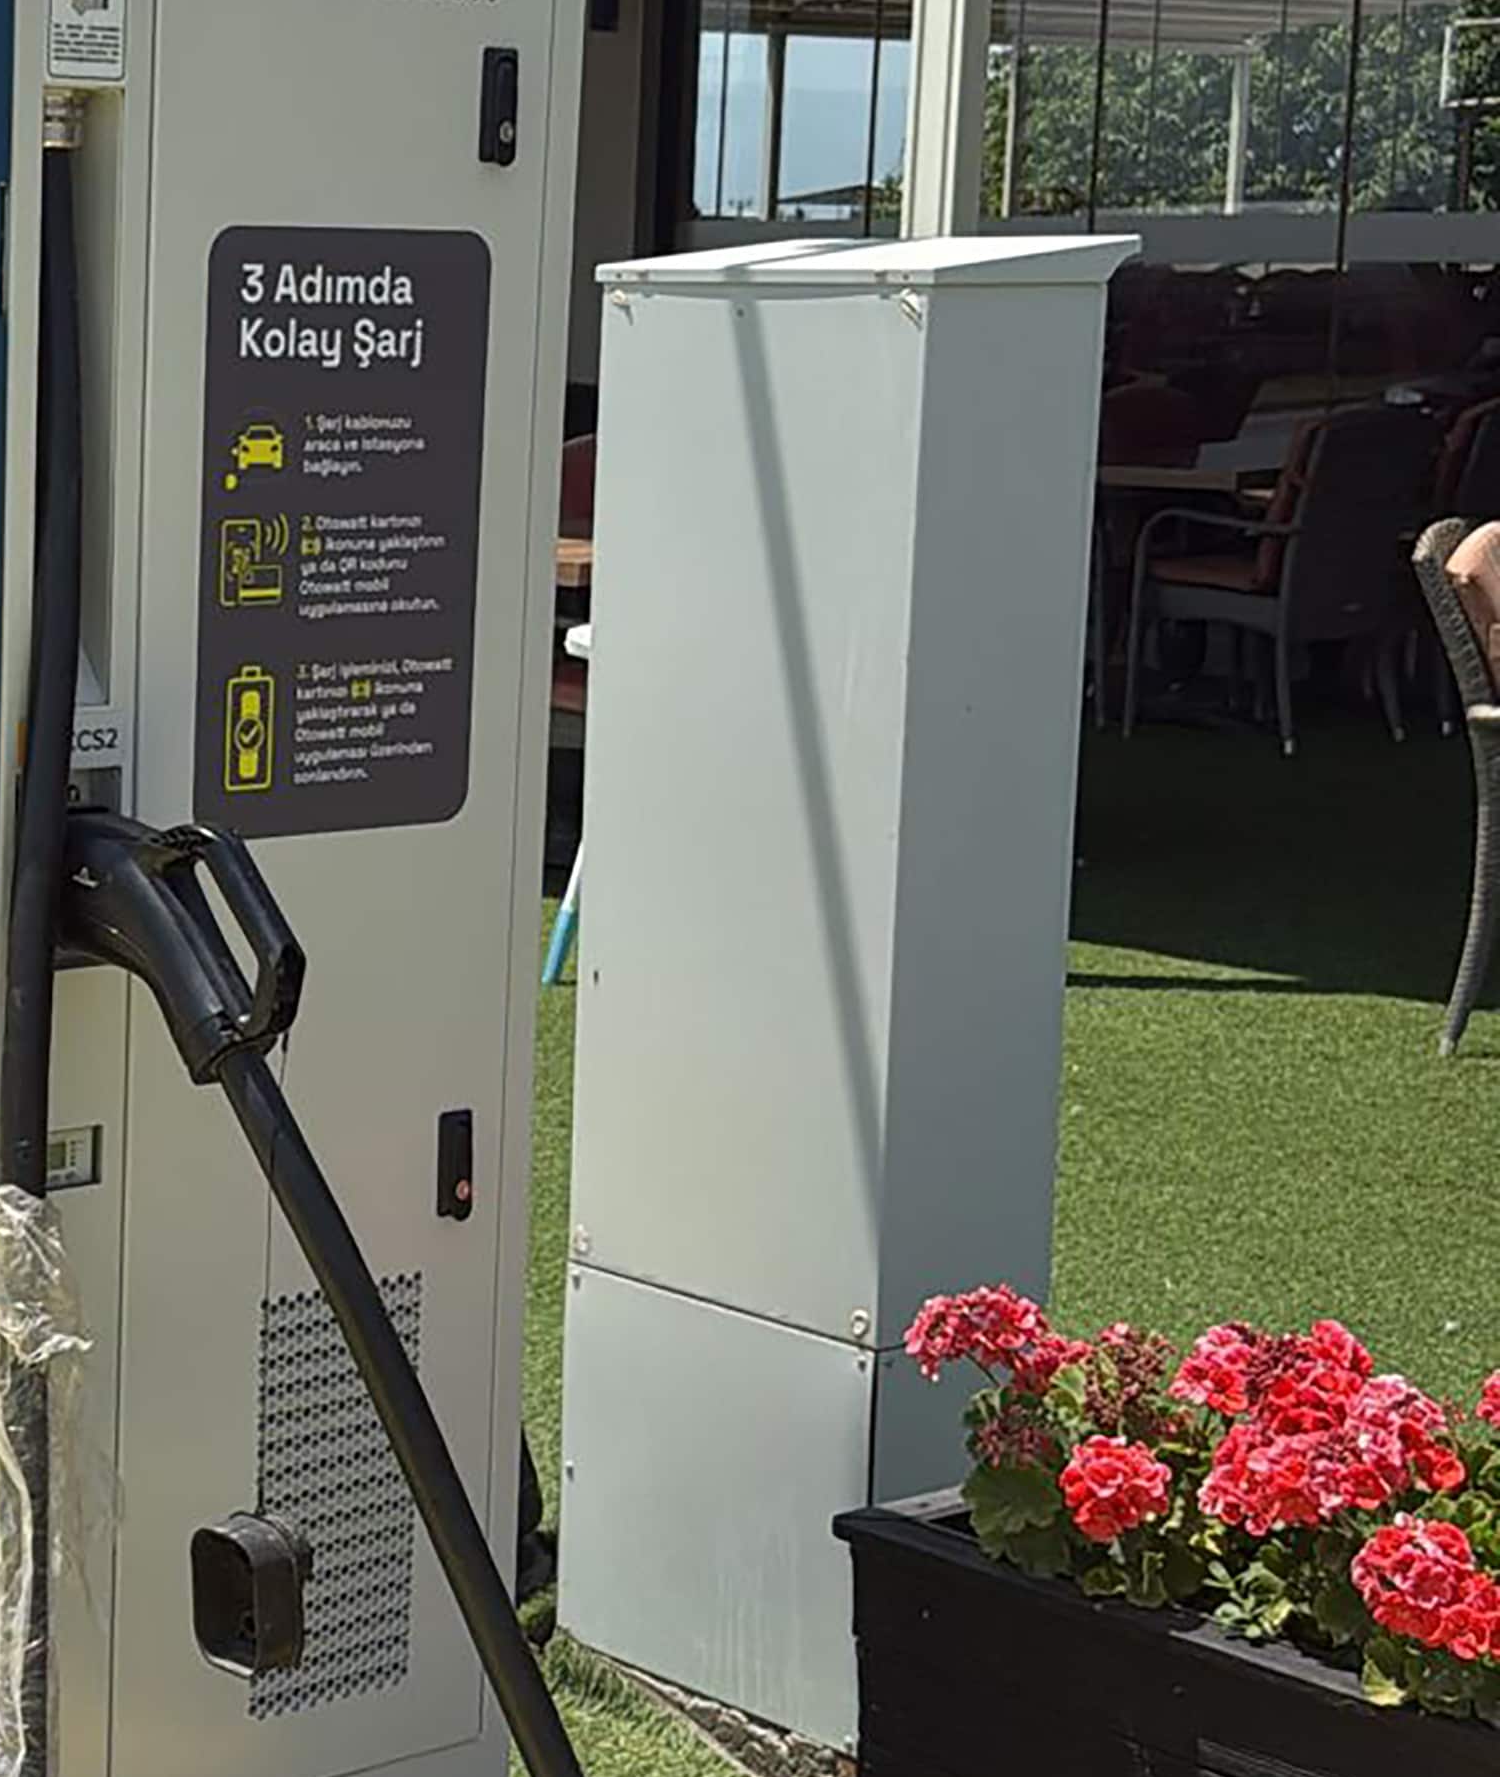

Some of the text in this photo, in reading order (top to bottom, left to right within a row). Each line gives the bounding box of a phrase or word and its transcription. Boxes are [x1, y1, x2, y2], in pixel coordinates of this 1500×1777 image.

[241, 263, 414, 304] 3 Adımda
[240, 318, 423, 368] Kolay Şarj
[73, 727, 118, 753] CS2
